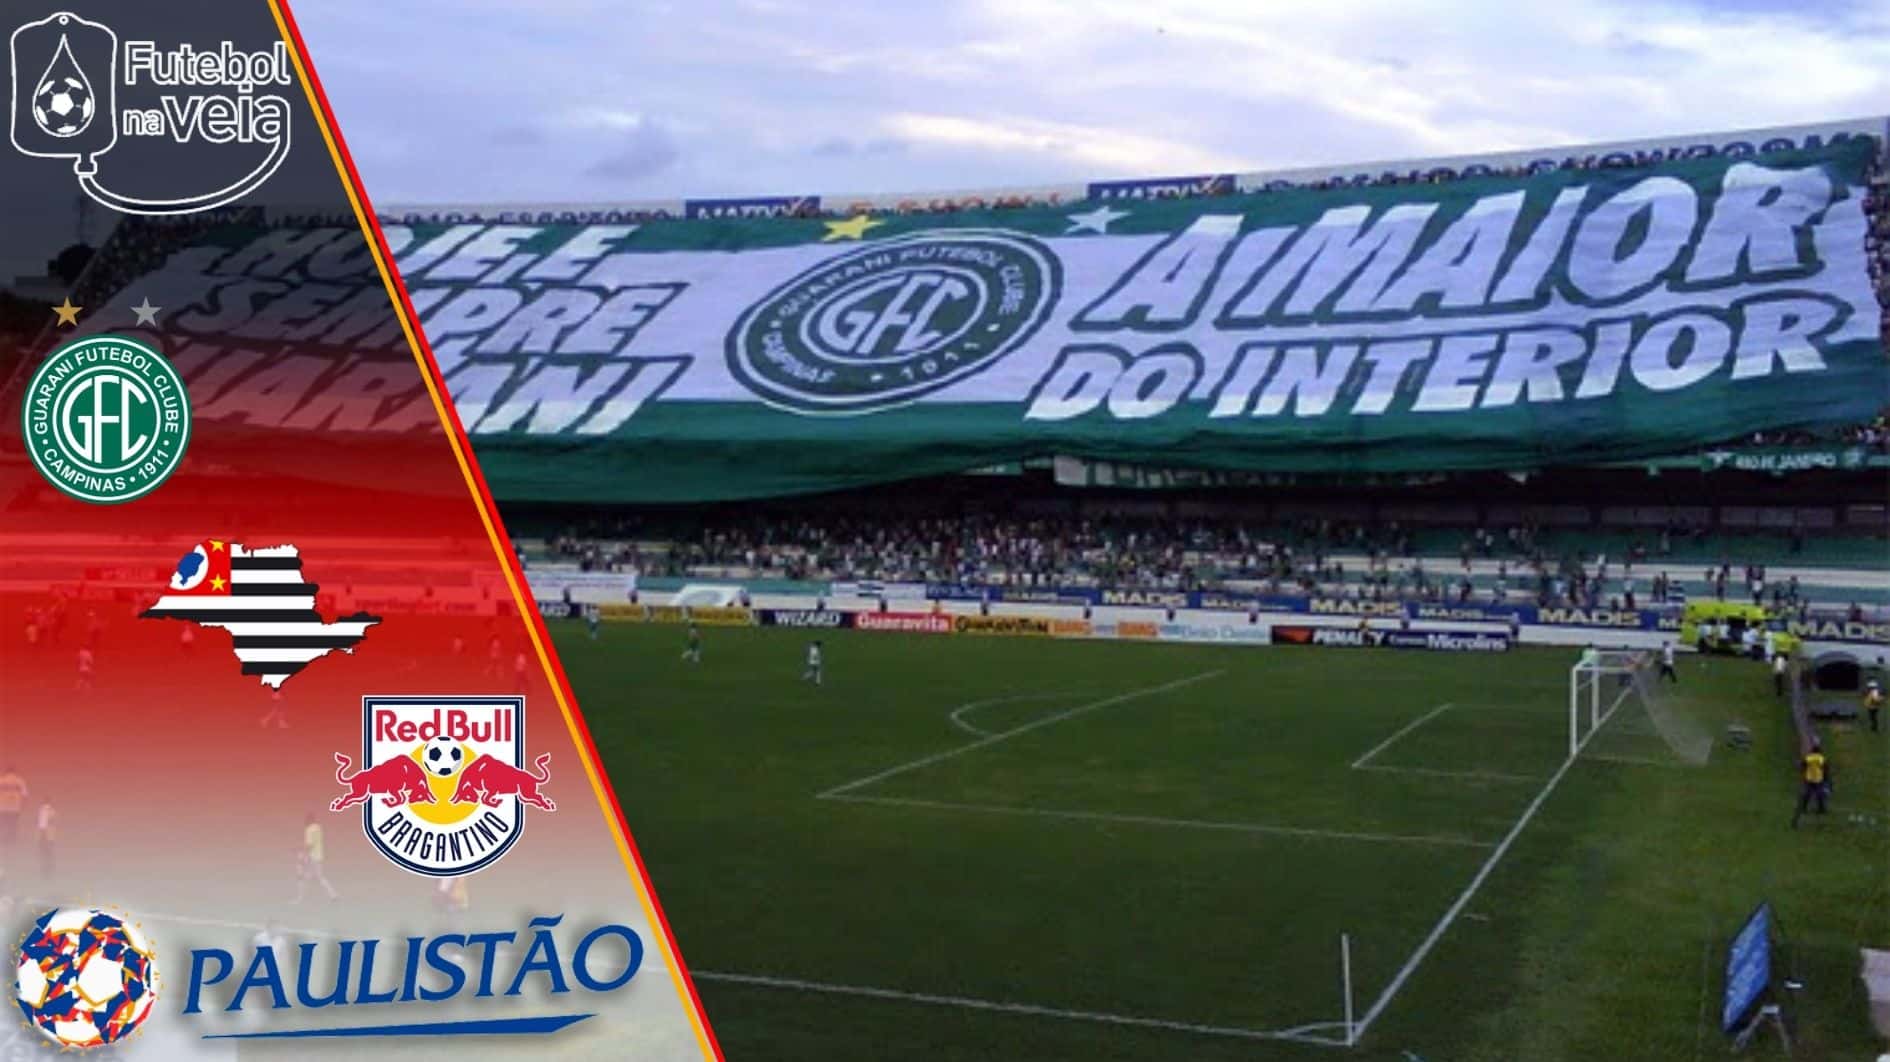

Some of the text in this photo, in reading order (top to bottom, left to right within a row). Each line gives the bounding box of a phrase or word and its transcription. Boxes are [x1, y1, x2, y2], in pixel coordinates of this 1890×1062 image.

[1228, 160, 1832, 317] MAIOR
[818, 272, 969, 356] GFC
[1023, 299, 1828, 421] DO INTERIOR
[774, 610, 841, 626] WIZARD
[856, 613, 949, 631] Guaravita
[1538, 608, 1641, 626] MADIS
[1427, 633, 1507, 651] Microlins
